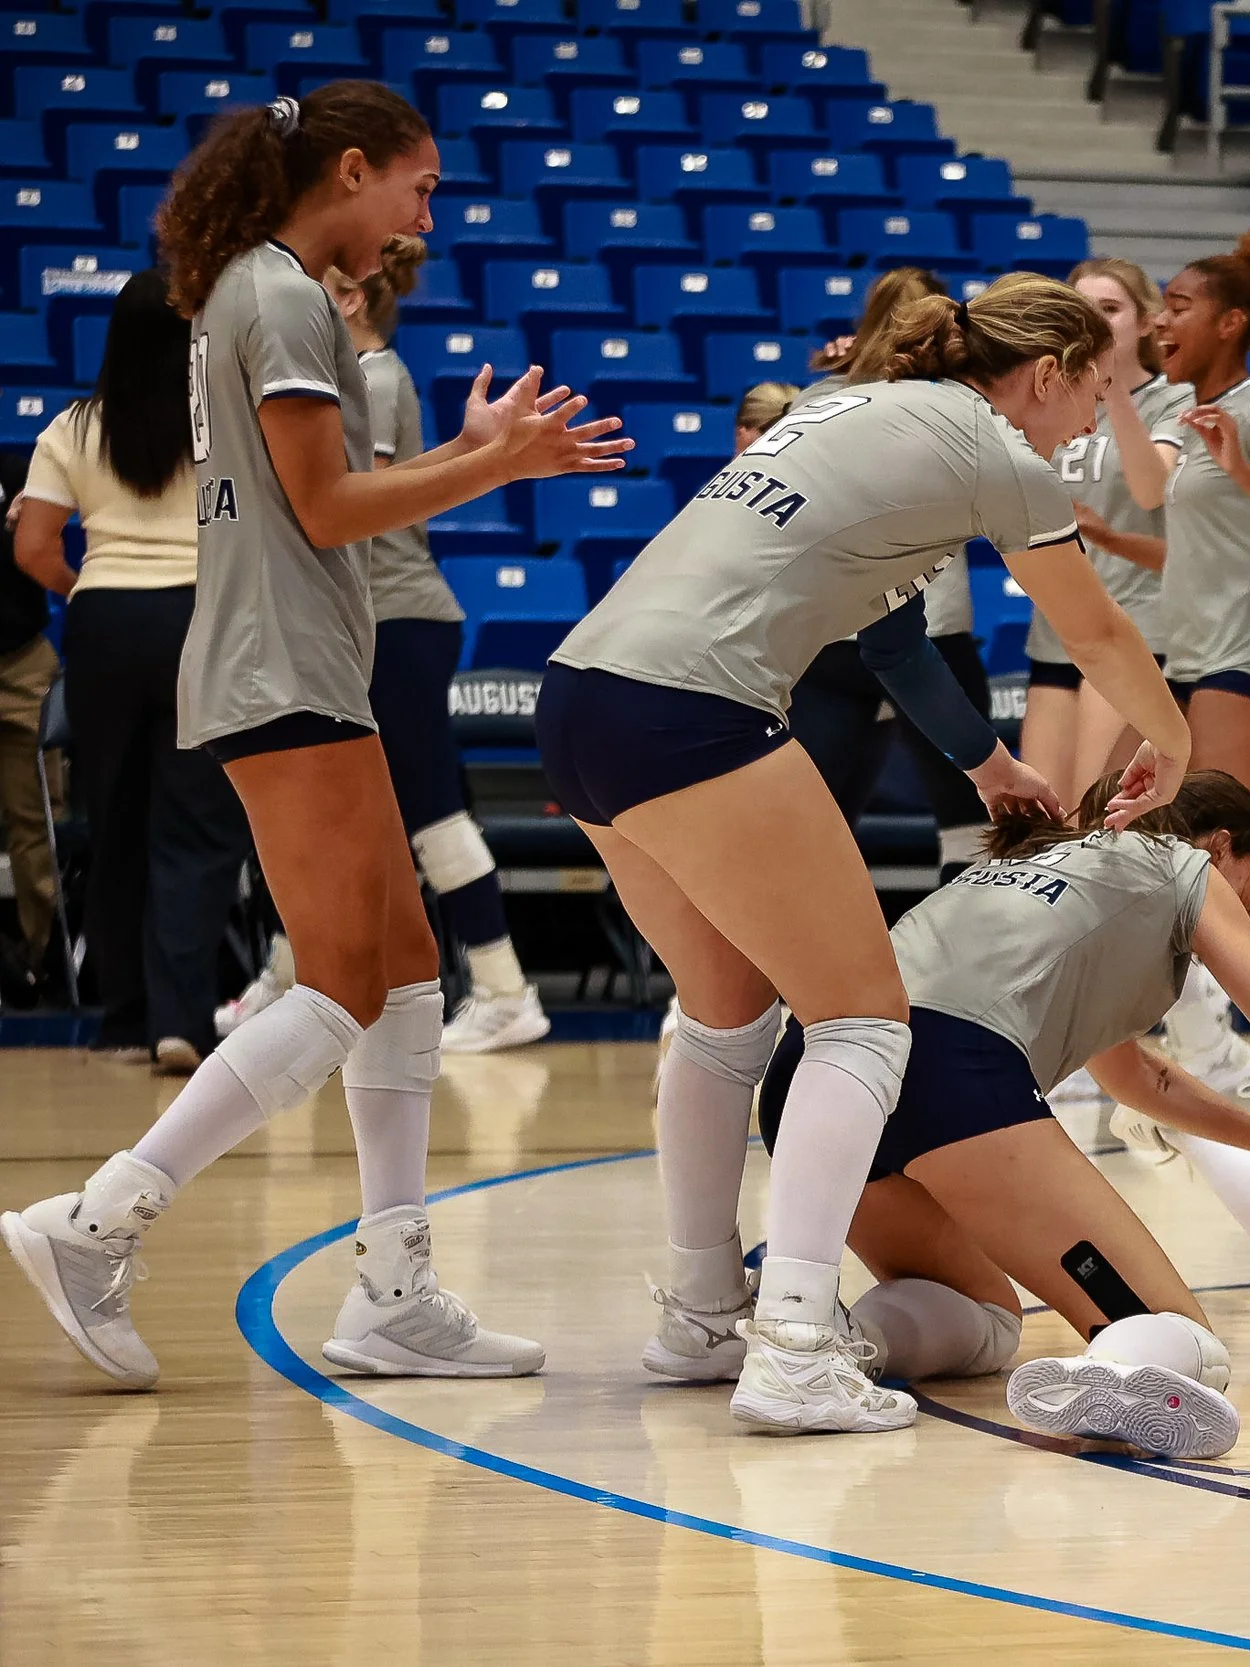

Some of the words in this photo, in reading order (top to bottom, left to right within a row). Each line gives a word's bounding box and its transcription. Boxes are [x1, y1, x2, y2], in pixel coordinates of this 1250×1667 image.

[741, 395, 873, 458] 2
[1061, 435, 1111, 482] 21
[447, 681, 541, 717] AUGUS
